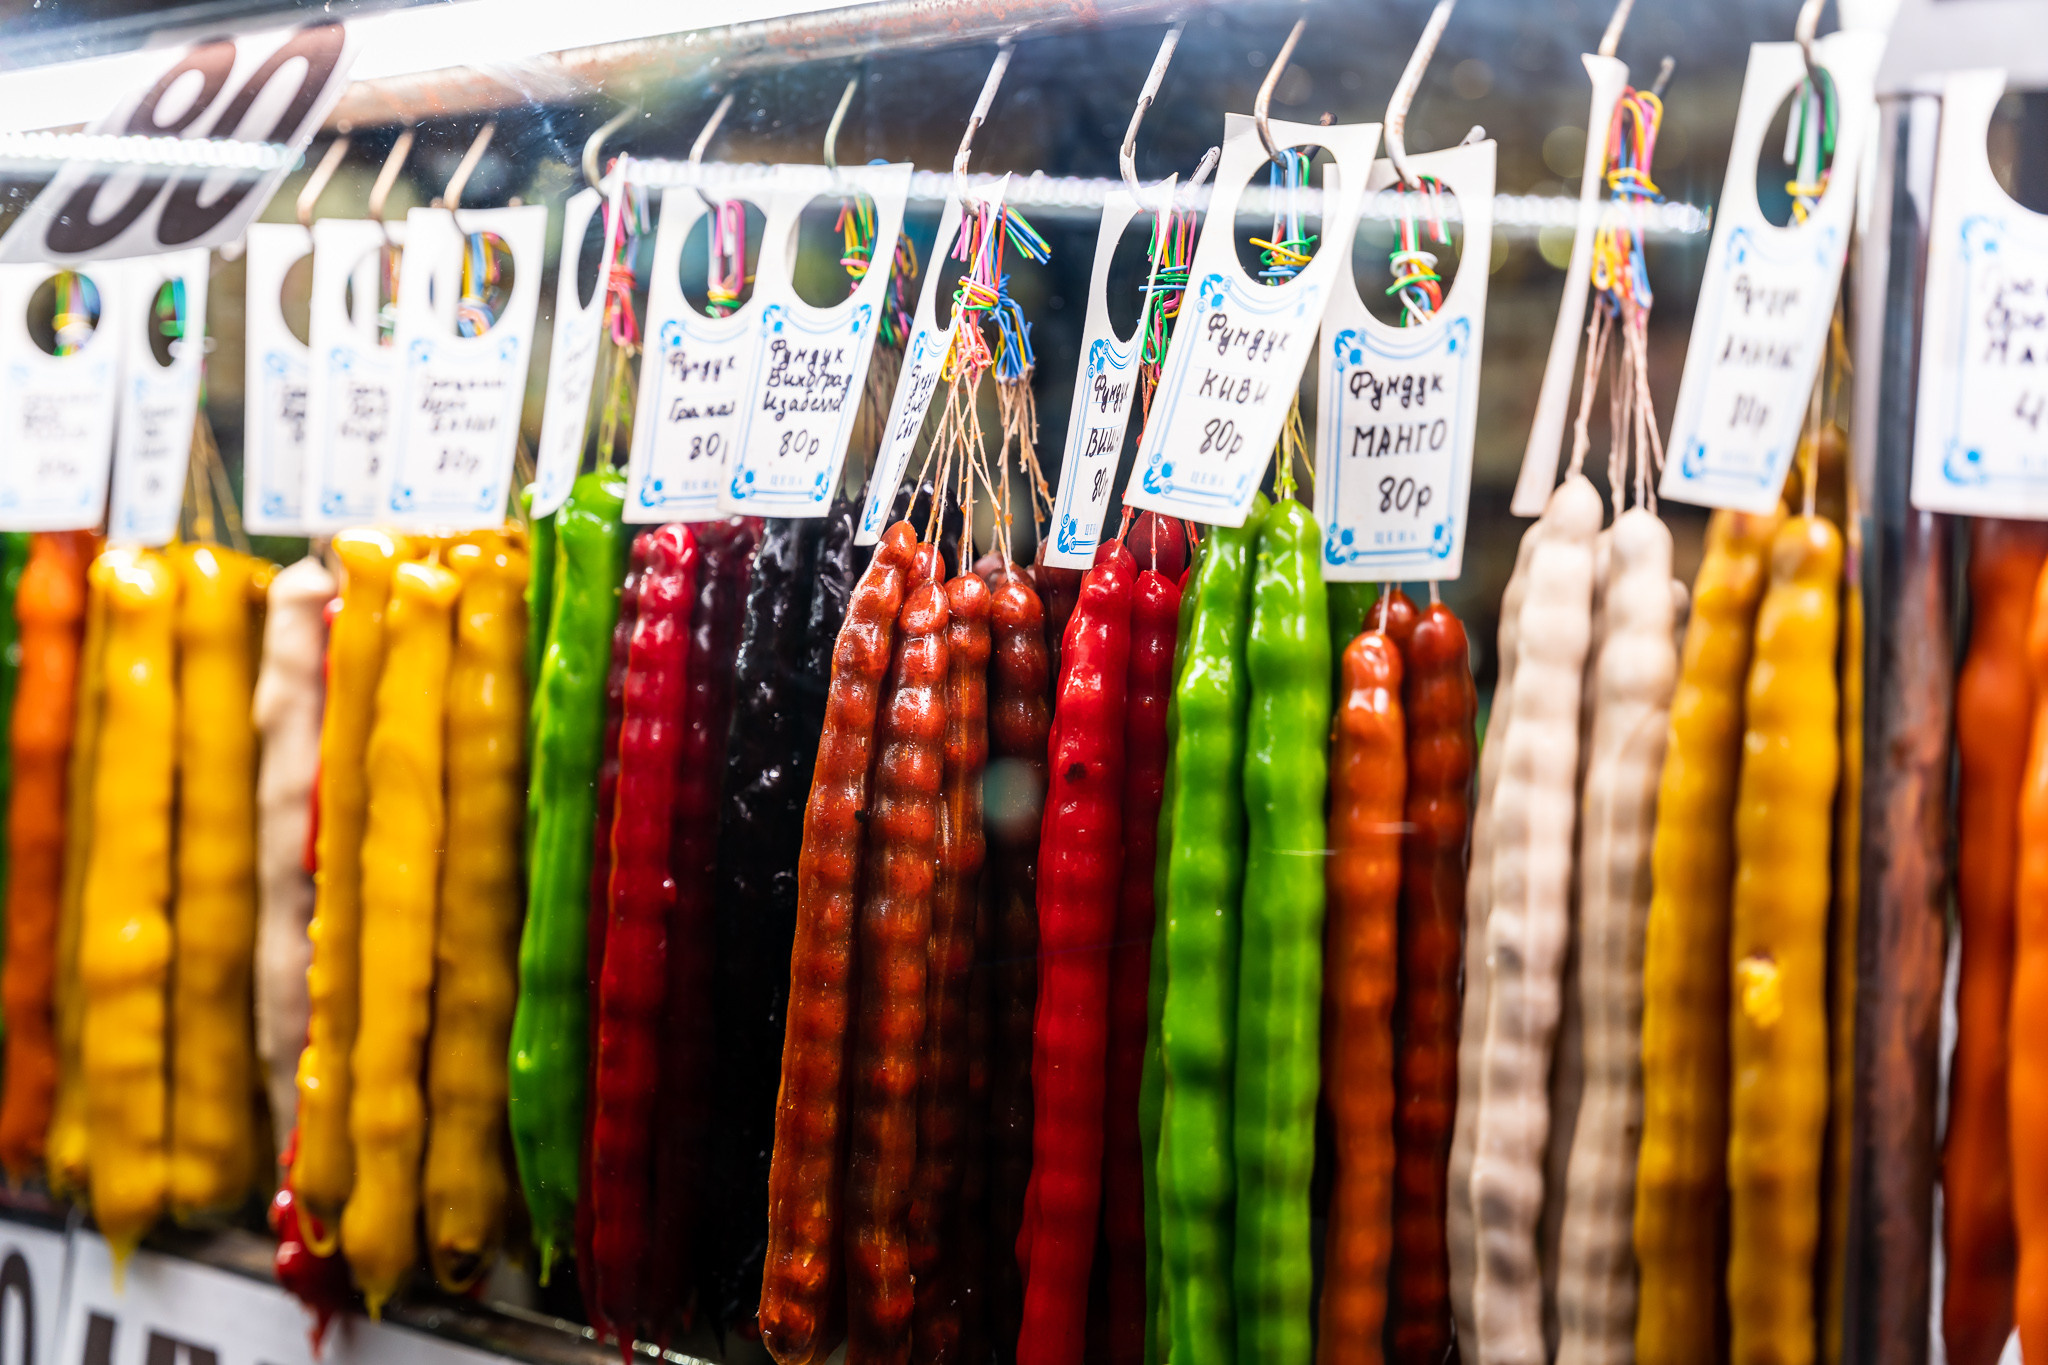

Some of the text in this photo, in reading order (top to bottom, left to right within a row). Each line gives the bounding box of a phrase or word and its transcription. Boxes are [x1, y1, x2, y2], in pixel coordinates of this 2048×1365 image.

[771, 339, 845, 371] Фундук
[1207, 313, 1291, 362] Фундук
[669, 351, 735, 382] Фундук
[1350, 371, 1444, 411] Фундук
[779, 429, 820, 462] 80р
[1199, 418, 1244, 462] 80р
[1352, 419, 1447, 457] МАНГО
[1379, 475, 1432, 518] 80р
